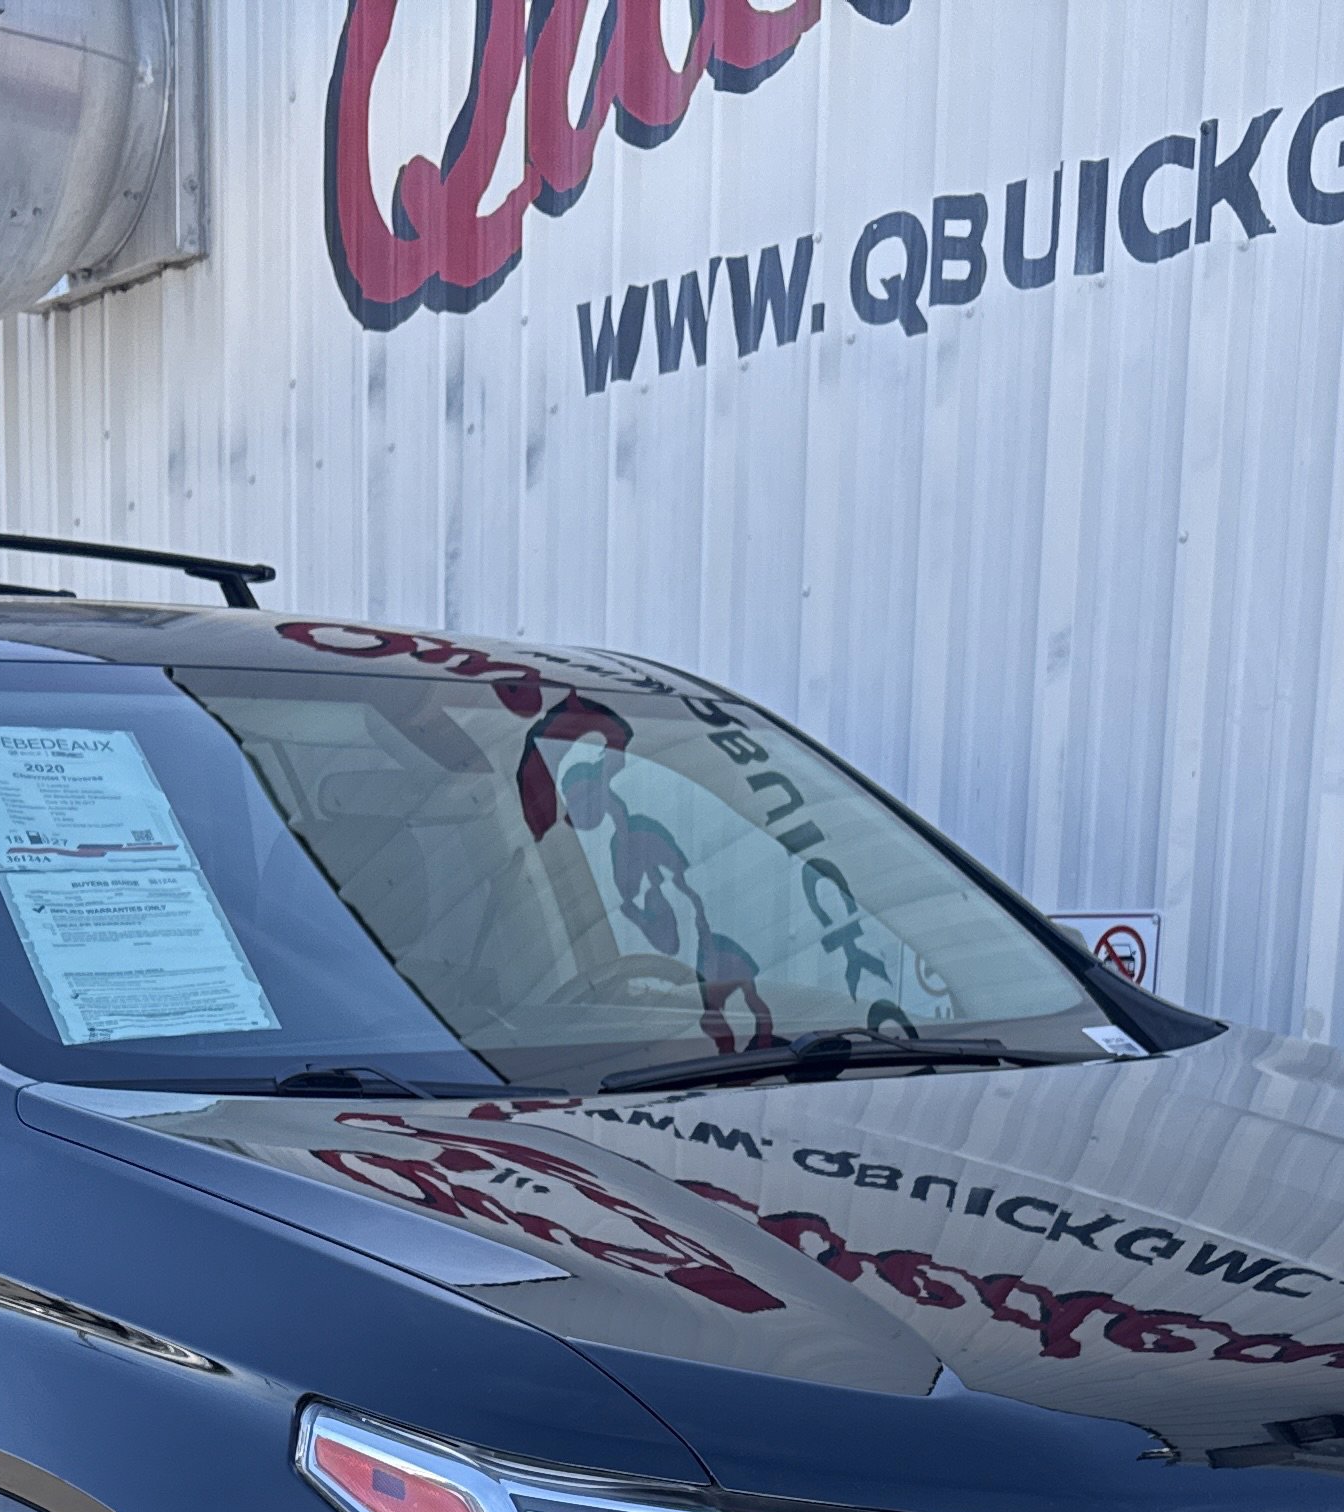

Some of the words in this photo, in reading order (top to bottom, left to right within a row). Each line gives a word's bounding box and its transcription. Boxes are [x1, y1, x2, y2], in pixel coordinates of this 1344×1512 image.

[24, 763, 65, 775] 2020
[5, 834, 24, 844] 18
[6, 855, 51, 863] 36124A
